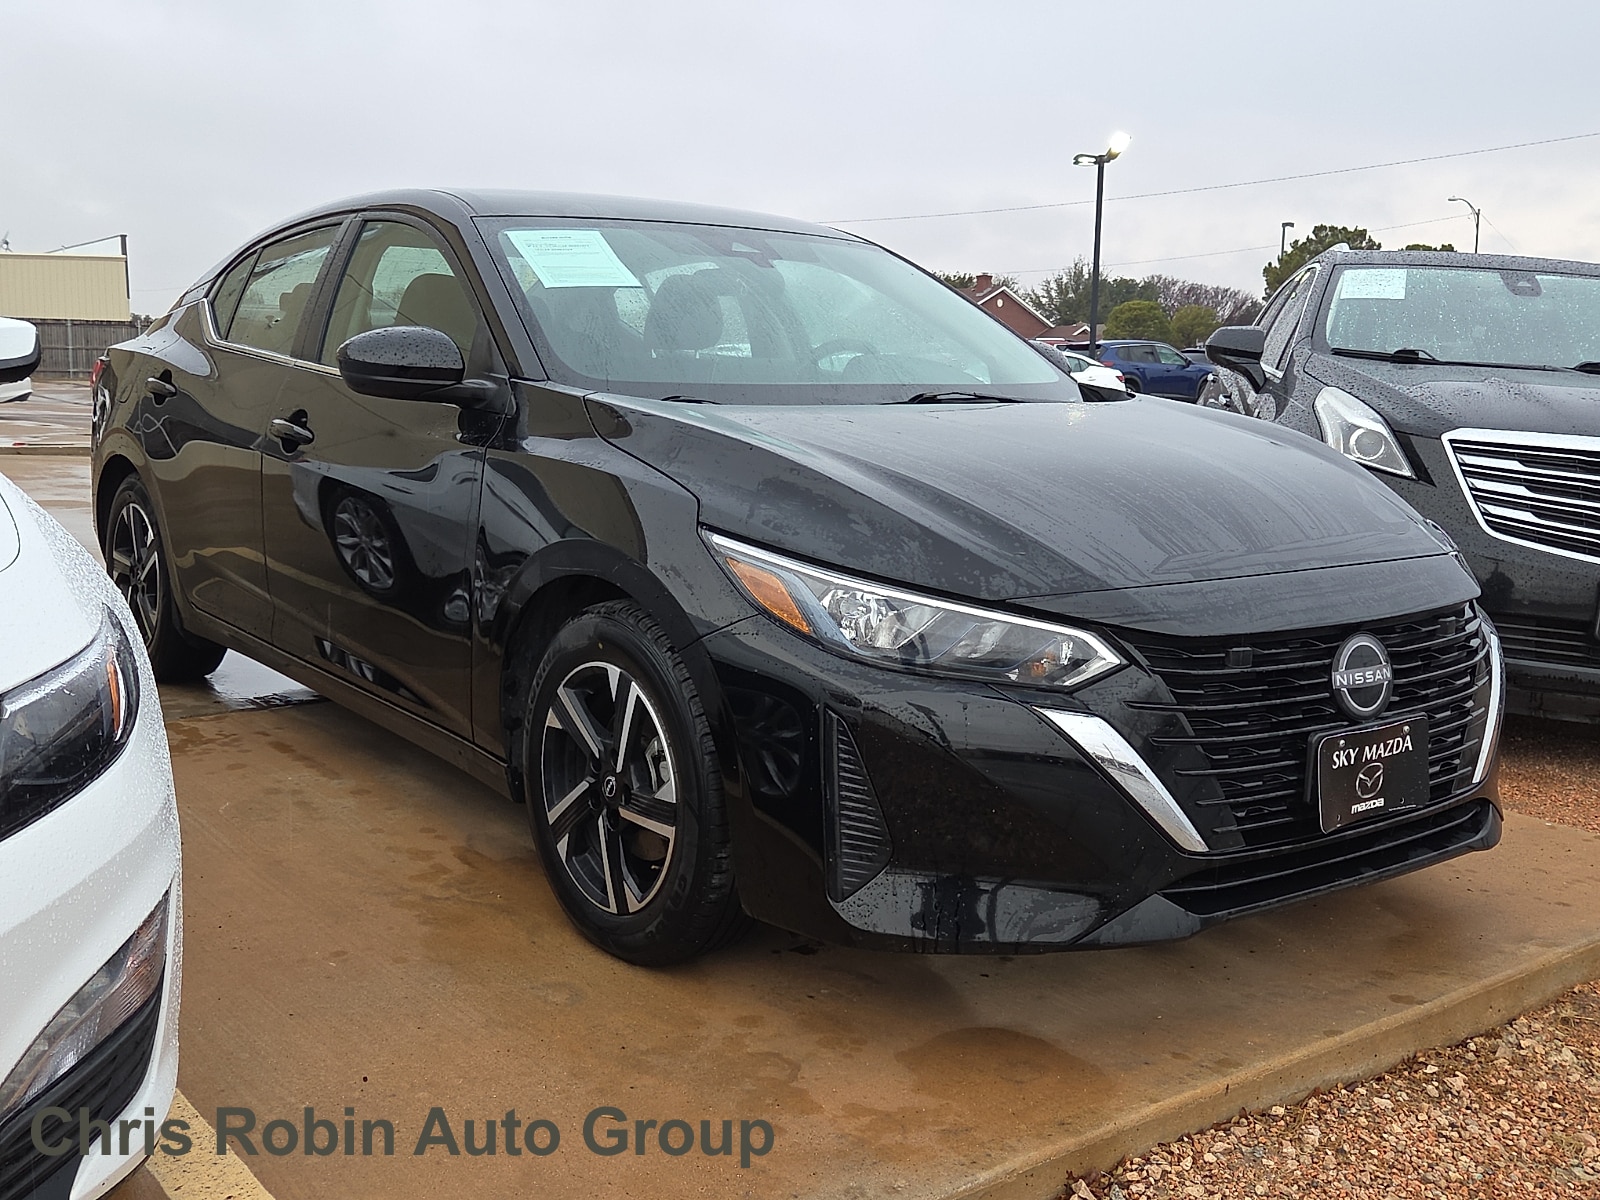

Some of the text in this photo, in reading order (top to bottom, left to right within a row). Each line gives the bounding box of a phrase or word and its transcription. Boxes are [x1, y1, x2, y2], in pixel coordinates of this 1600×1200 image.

[1336, 667, 1391, 686] NISSAN
[1332, 735, 1413, 769] SKY MAZDA
